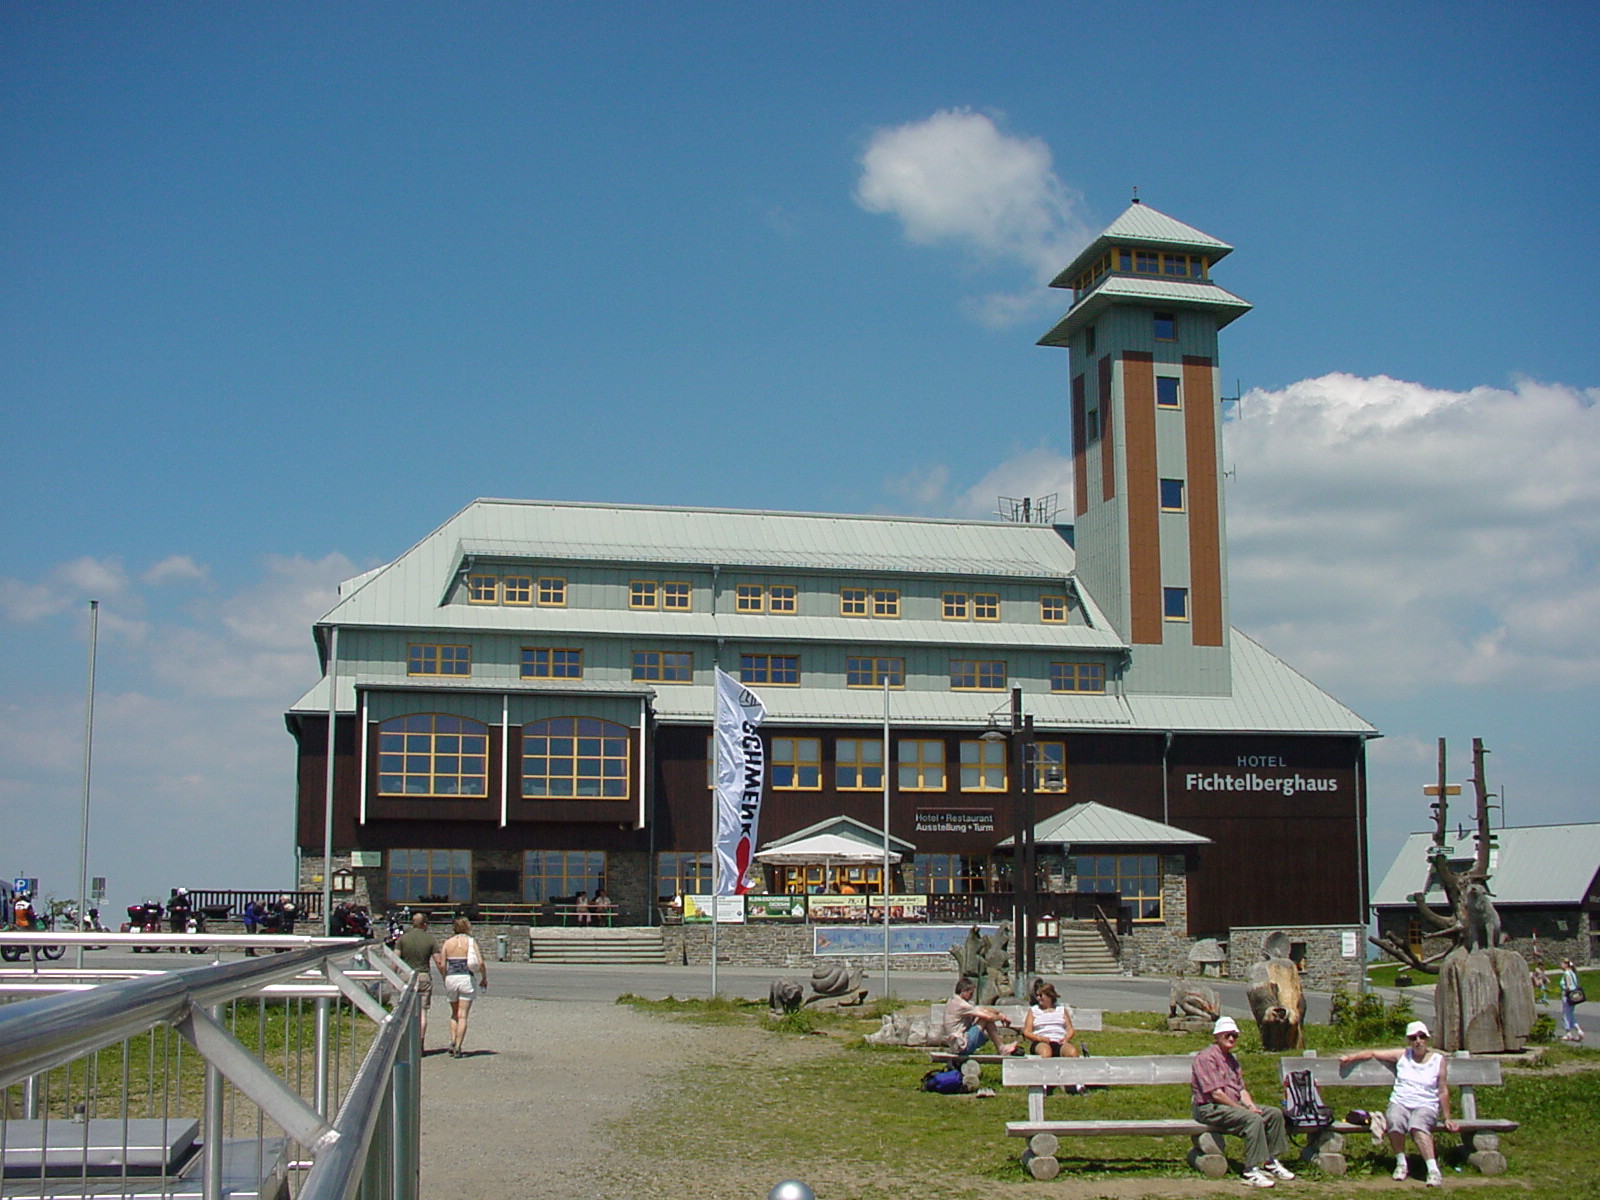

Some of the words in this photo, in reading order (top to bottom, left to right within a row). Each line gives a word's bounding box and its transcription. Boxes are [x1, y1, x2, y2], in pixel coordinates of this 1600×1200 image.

[1237, 755, 1287, 768] HOTEL
[1186, 773, 1338, 796] Fichtelberghaus
[915, 813, 939, 822] Hotel
[945, 813, 993, 822] Restaurant
[915, 823, 967, 833] Ausstellung
[973, 823, 994, 832] Turm
[16, 879, 26, 891] P
